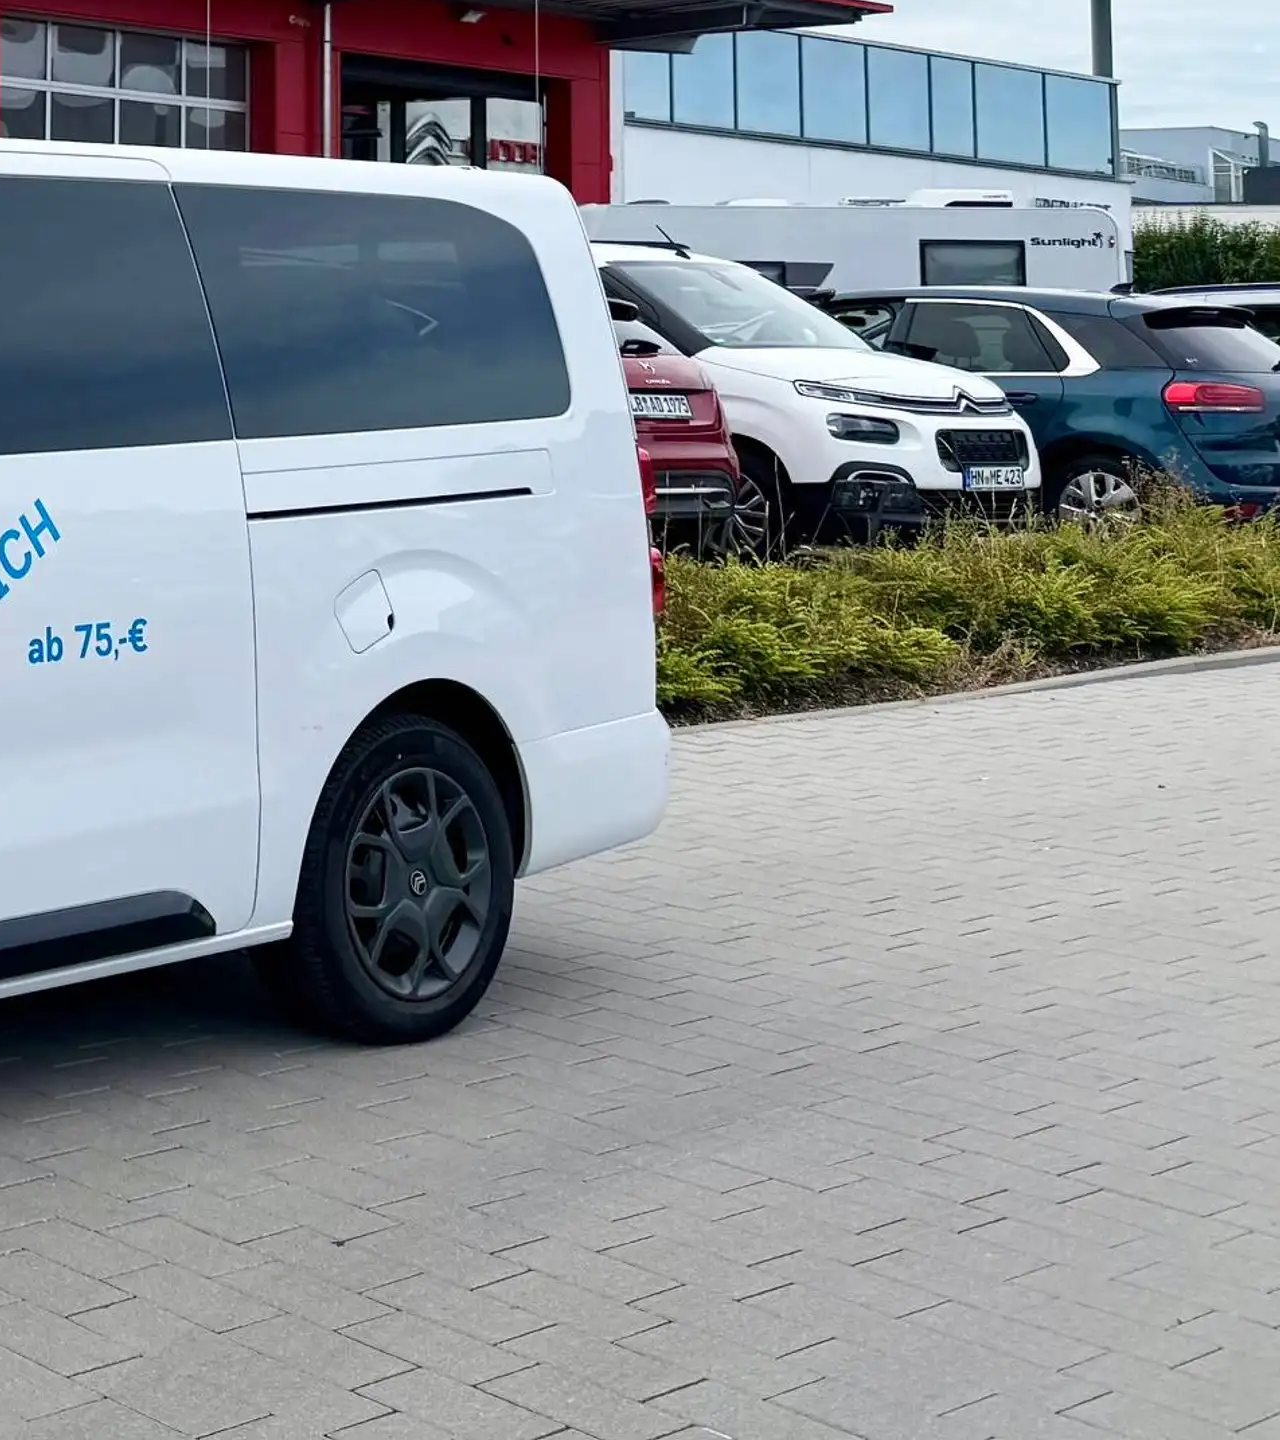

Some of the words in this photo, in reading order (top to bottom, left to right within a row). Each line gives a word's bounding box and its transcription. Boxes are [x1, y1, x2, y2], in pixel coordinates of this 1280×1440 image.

[1030, 236, 1098, 249] Sunlight
[28, 626, 64, 664] ab
[74, 618, 149, 661] 75,-€
